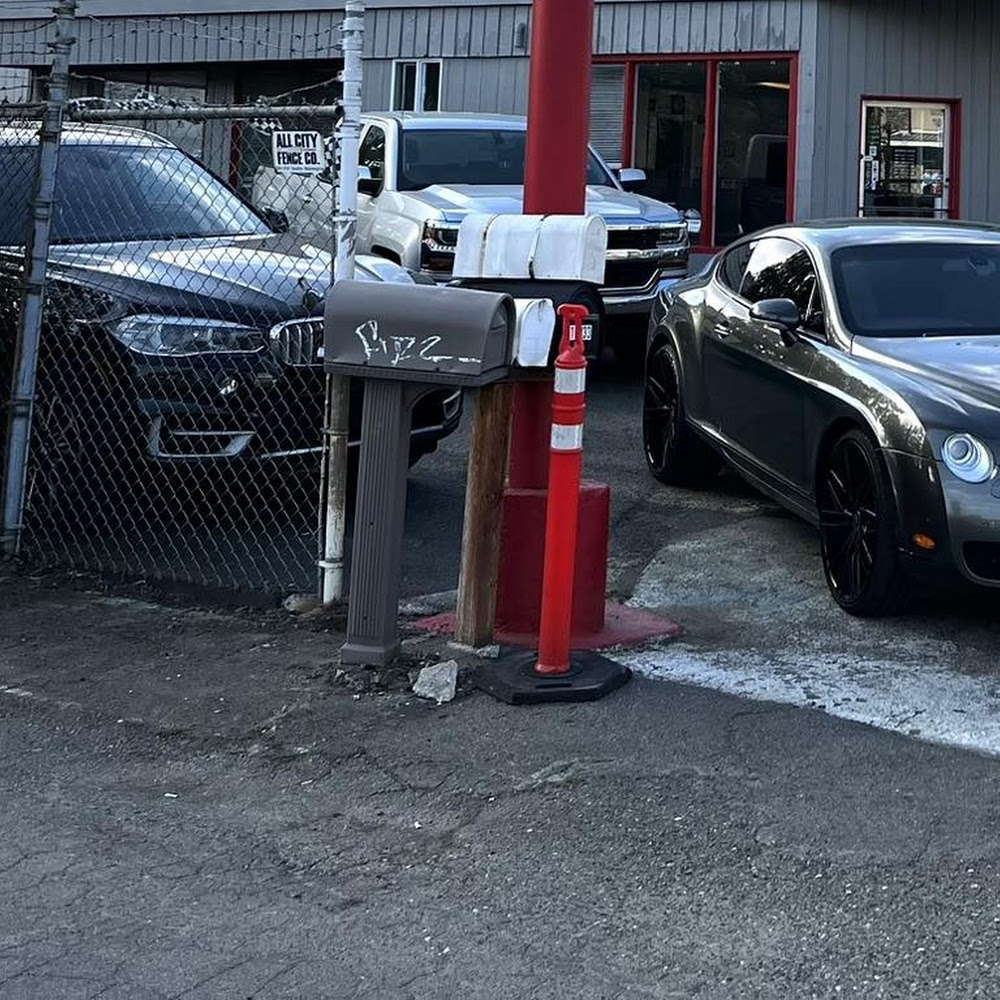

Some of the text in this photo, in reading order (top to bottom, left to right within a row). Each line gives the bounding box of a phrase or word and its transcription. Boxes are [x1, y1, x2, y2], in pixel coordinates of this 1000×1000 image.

[277, 133, 317, 148] ALL CITY
[277, 151, 320, 165] FENCE CO.
